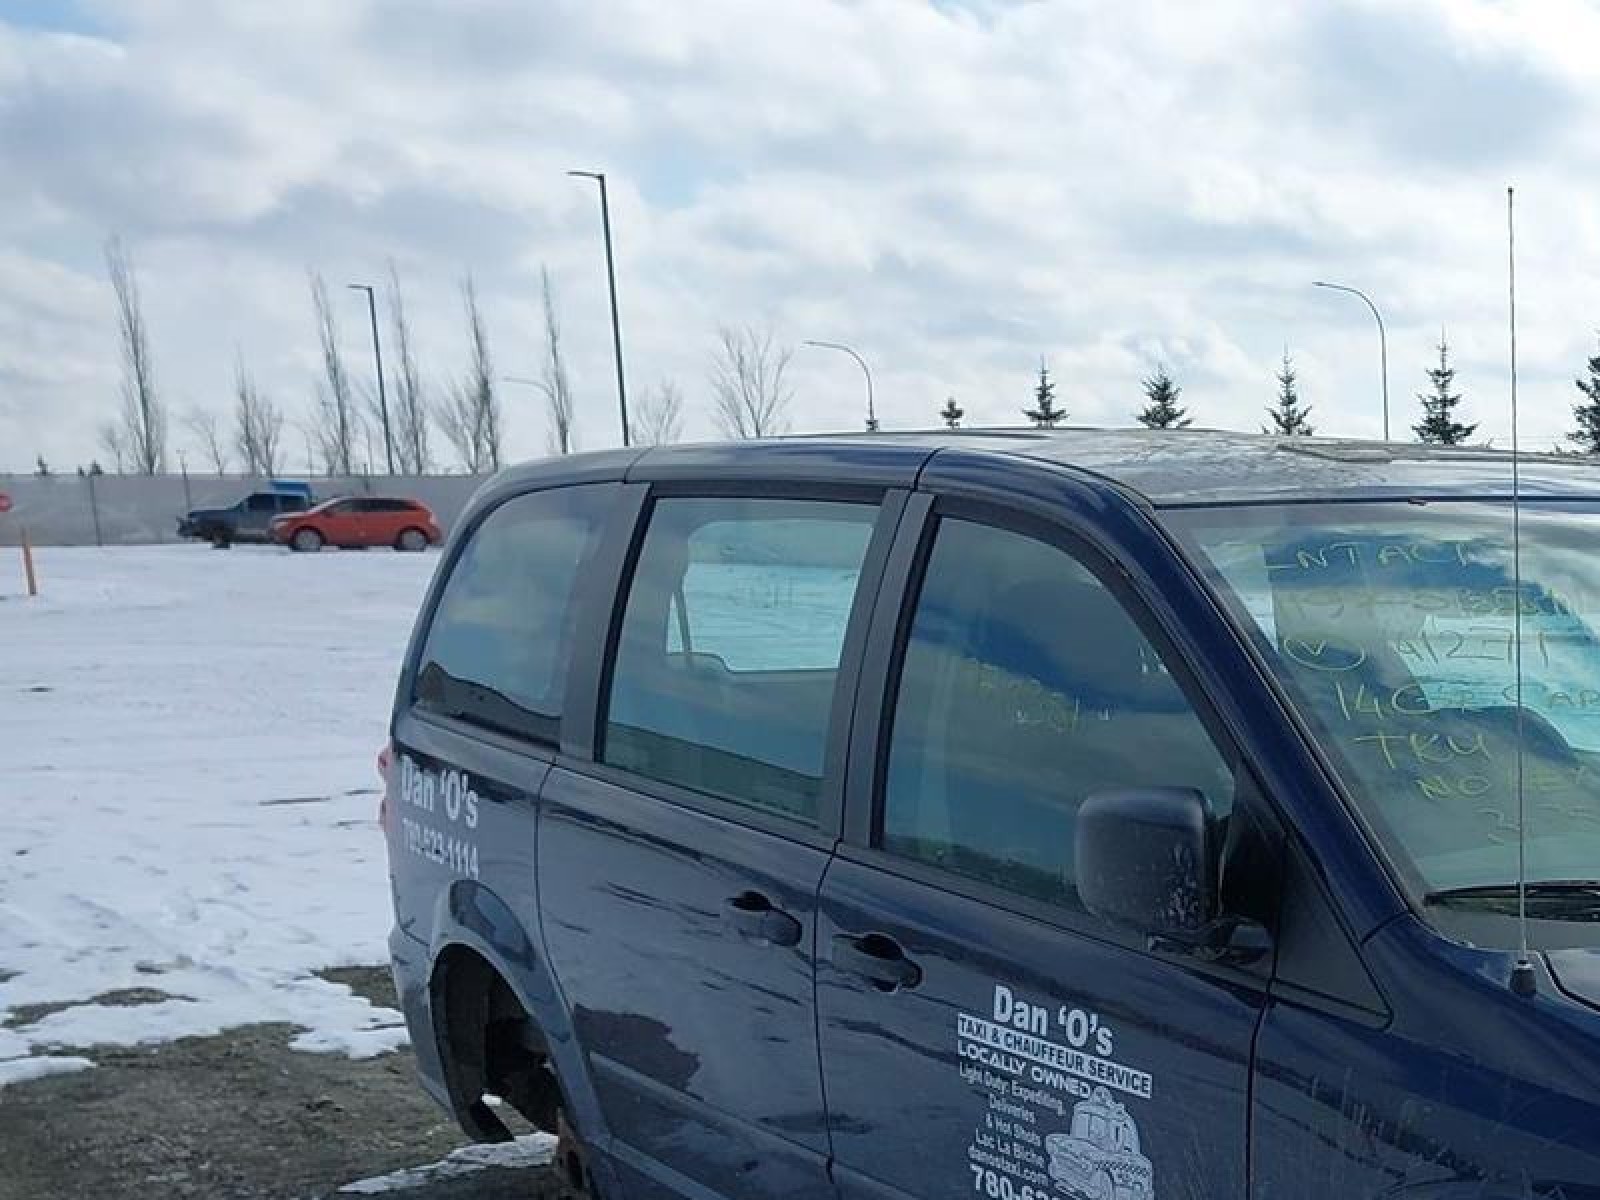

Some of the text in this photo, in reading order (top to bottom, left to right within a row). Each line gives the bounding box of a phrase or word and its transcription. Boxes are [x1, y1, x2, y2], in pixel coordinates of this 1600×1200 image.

[401, 755, 436, 812] Dan
[993, 984, 1049, 1037] Dan
[957, 1039, 1092, 1099] LOCALLY OWNED
[960, 1016, 988, 1041] TAXI
[1003, 1029, 1084, 1076] CHAUFFEUR
[1088, 1057, 1151, 1094] SERVICE
[975, 1127, 995, 1149] Lac
[997, 1135, 1011, 1155] La
